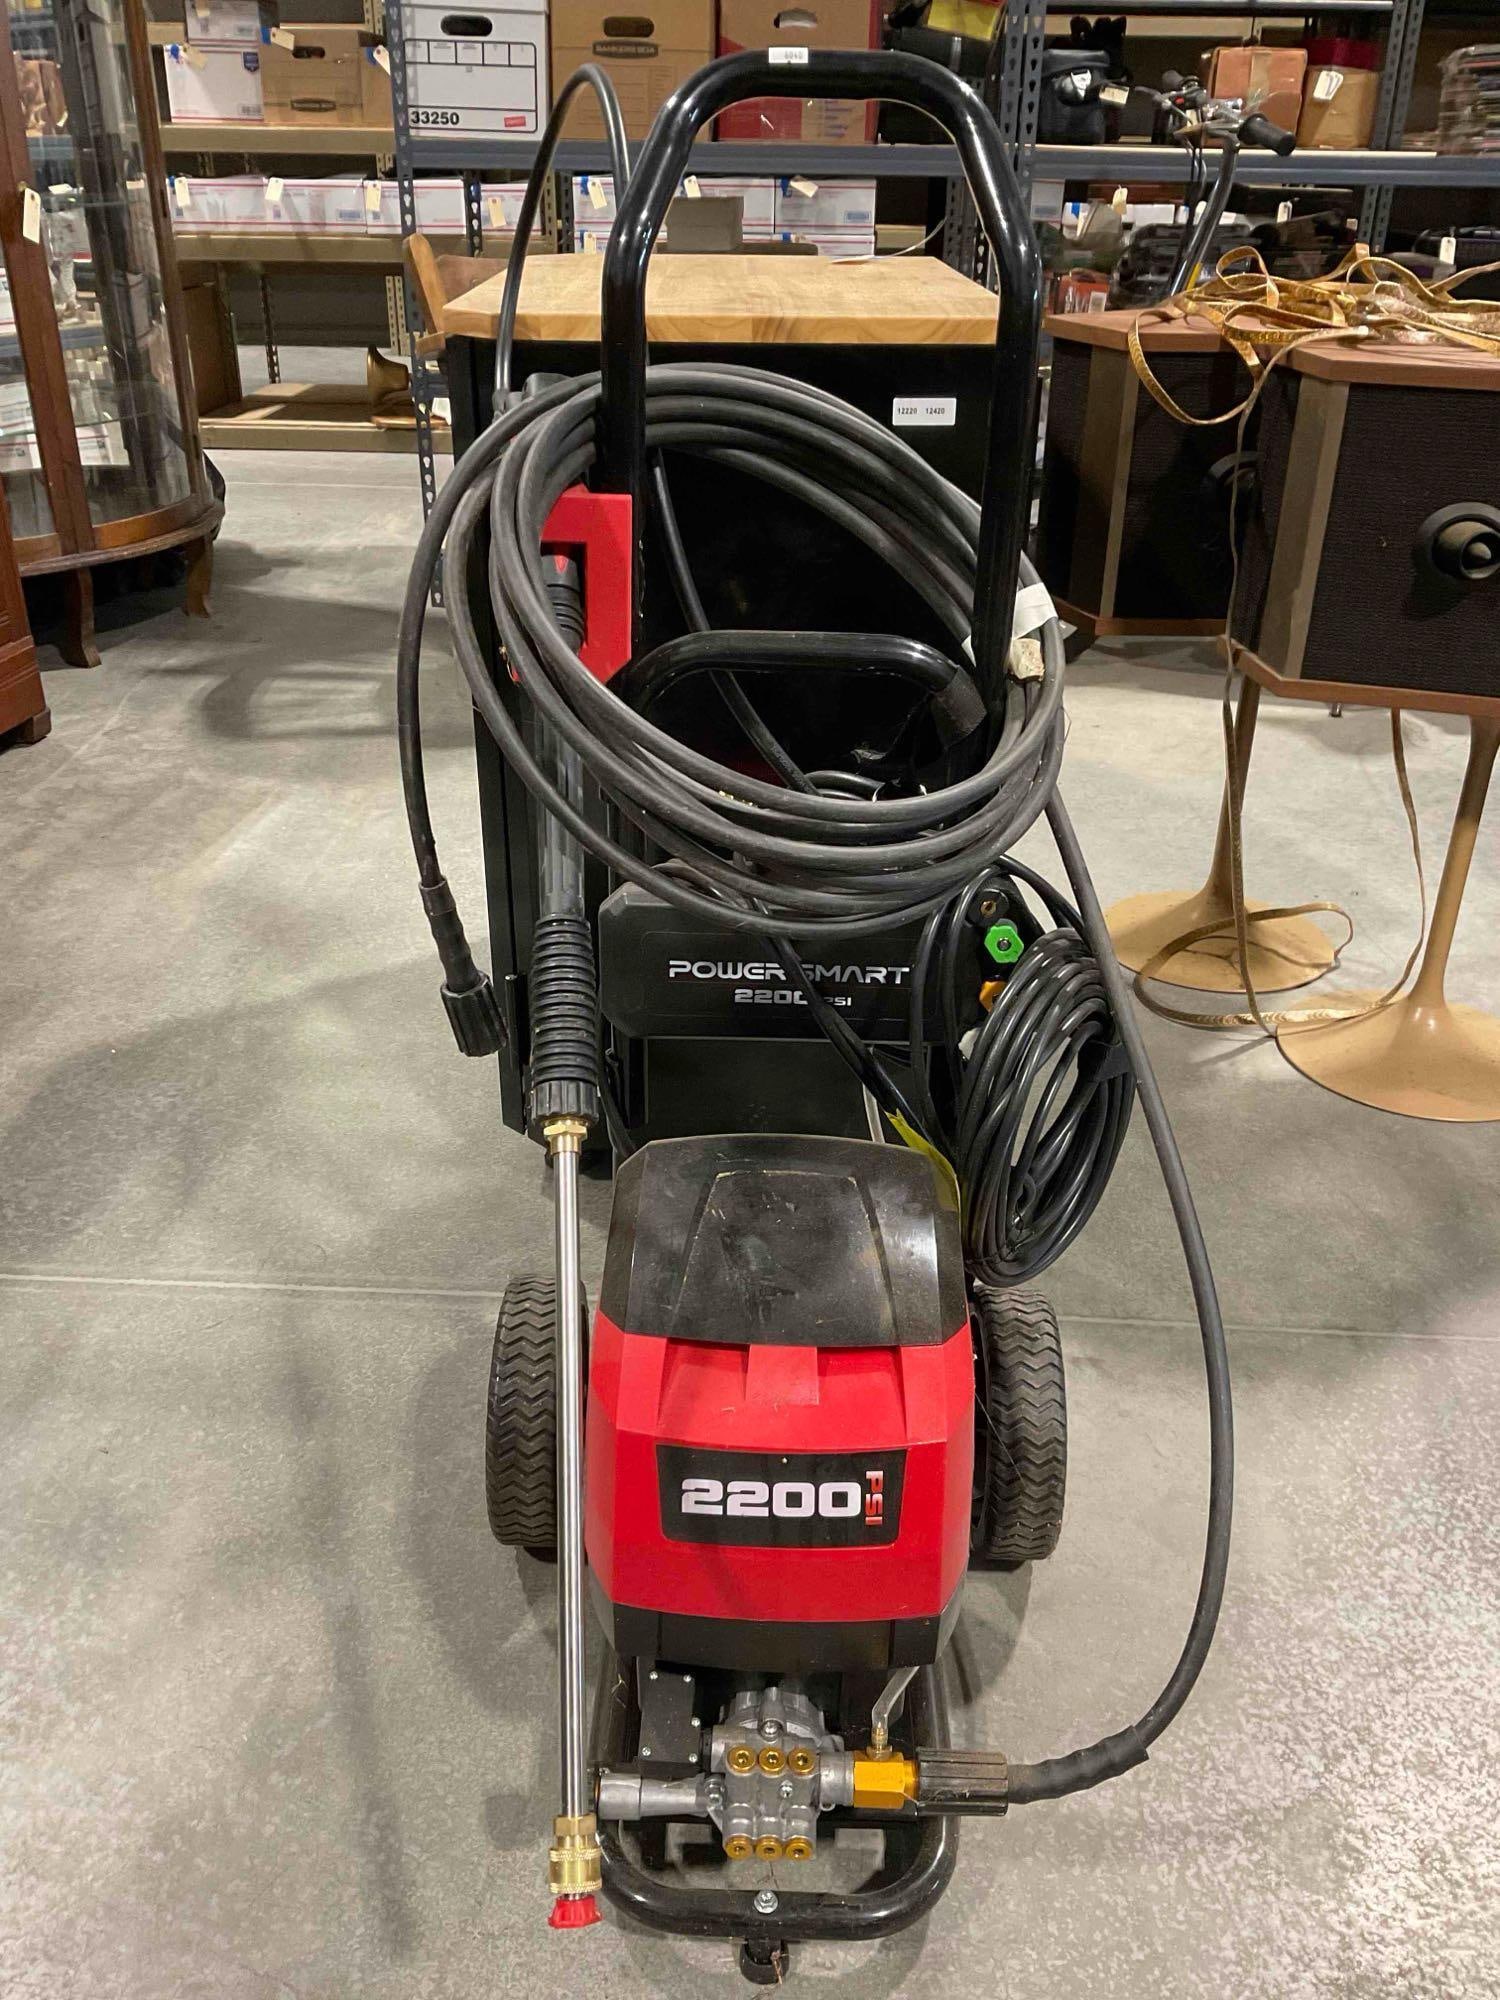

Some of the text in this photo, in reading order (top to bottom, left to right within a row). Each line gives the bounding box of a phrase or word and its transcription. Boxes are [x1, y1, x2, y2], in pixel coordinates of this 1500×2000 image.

[410, 110, 460, 126] 33250
[681, 1470, 884, 1526] 2200 PSI
